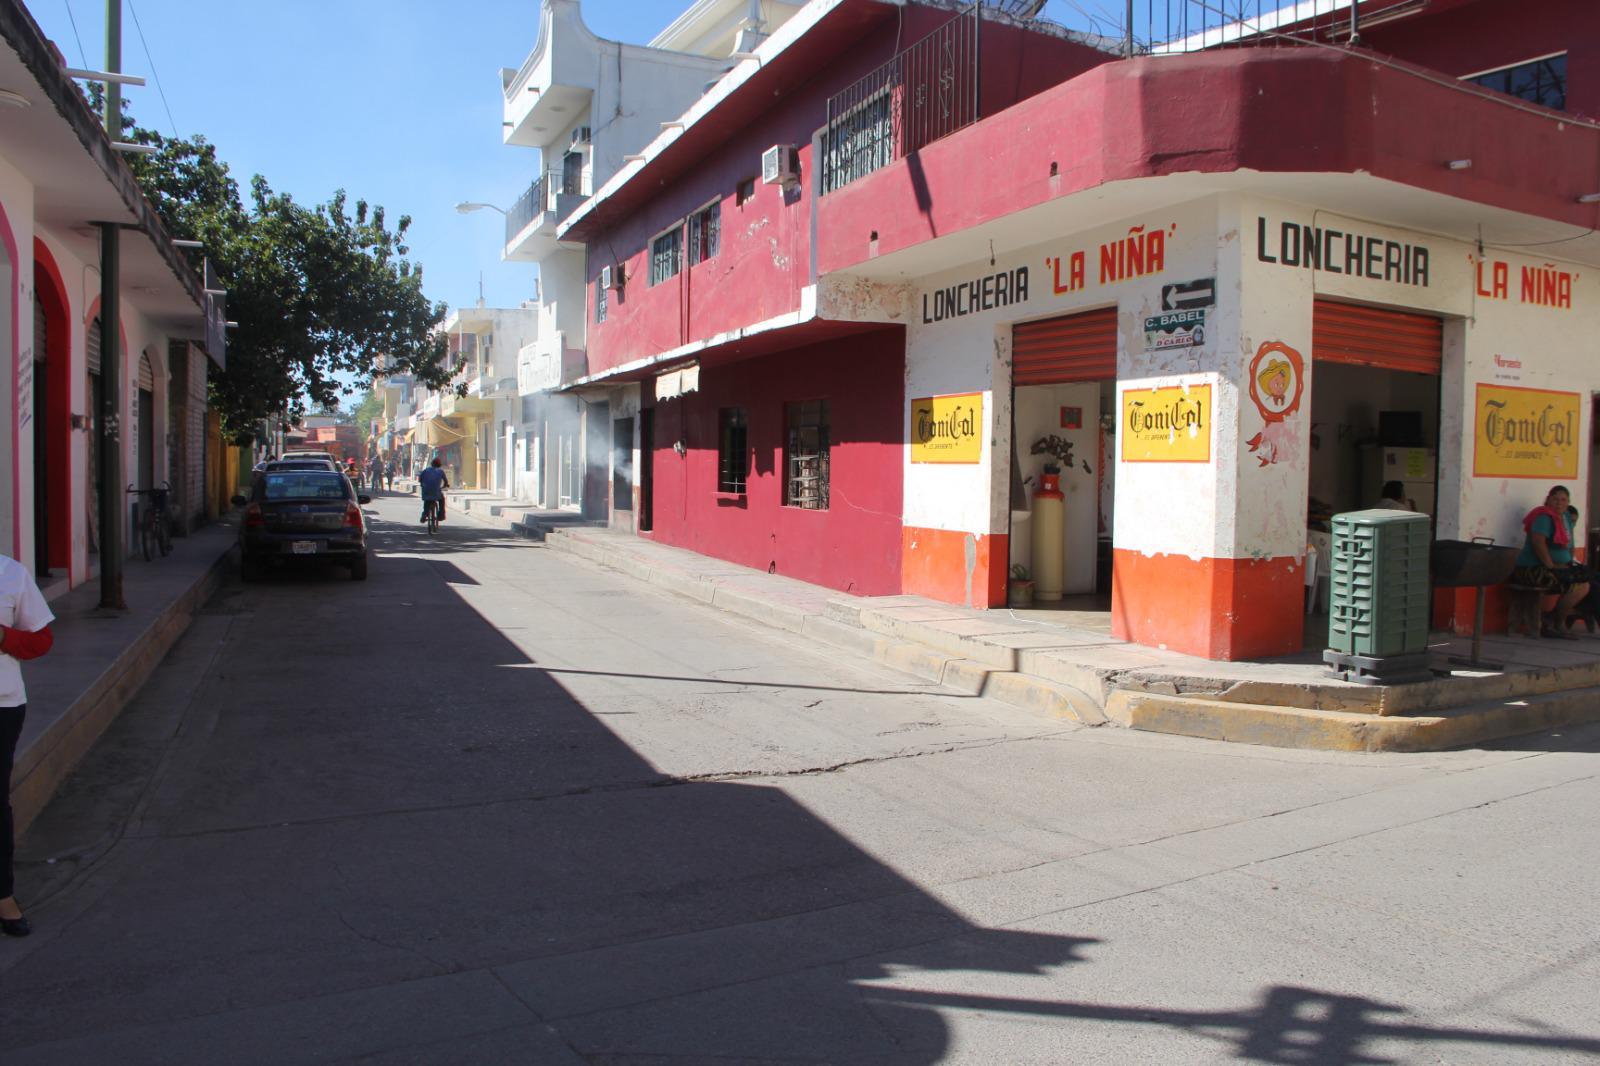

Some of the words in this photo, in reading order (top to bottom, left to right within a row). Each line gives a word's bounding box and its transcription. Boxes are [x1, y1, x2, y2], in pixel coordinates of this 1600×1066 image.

[1257, 217, 1429, 287] LONCHERIA
[922, 265, 1029, 325] LONCHERIA
[1145, 318, 1158, 328] C.
[1161, 311, 1203, 325] BABEL
